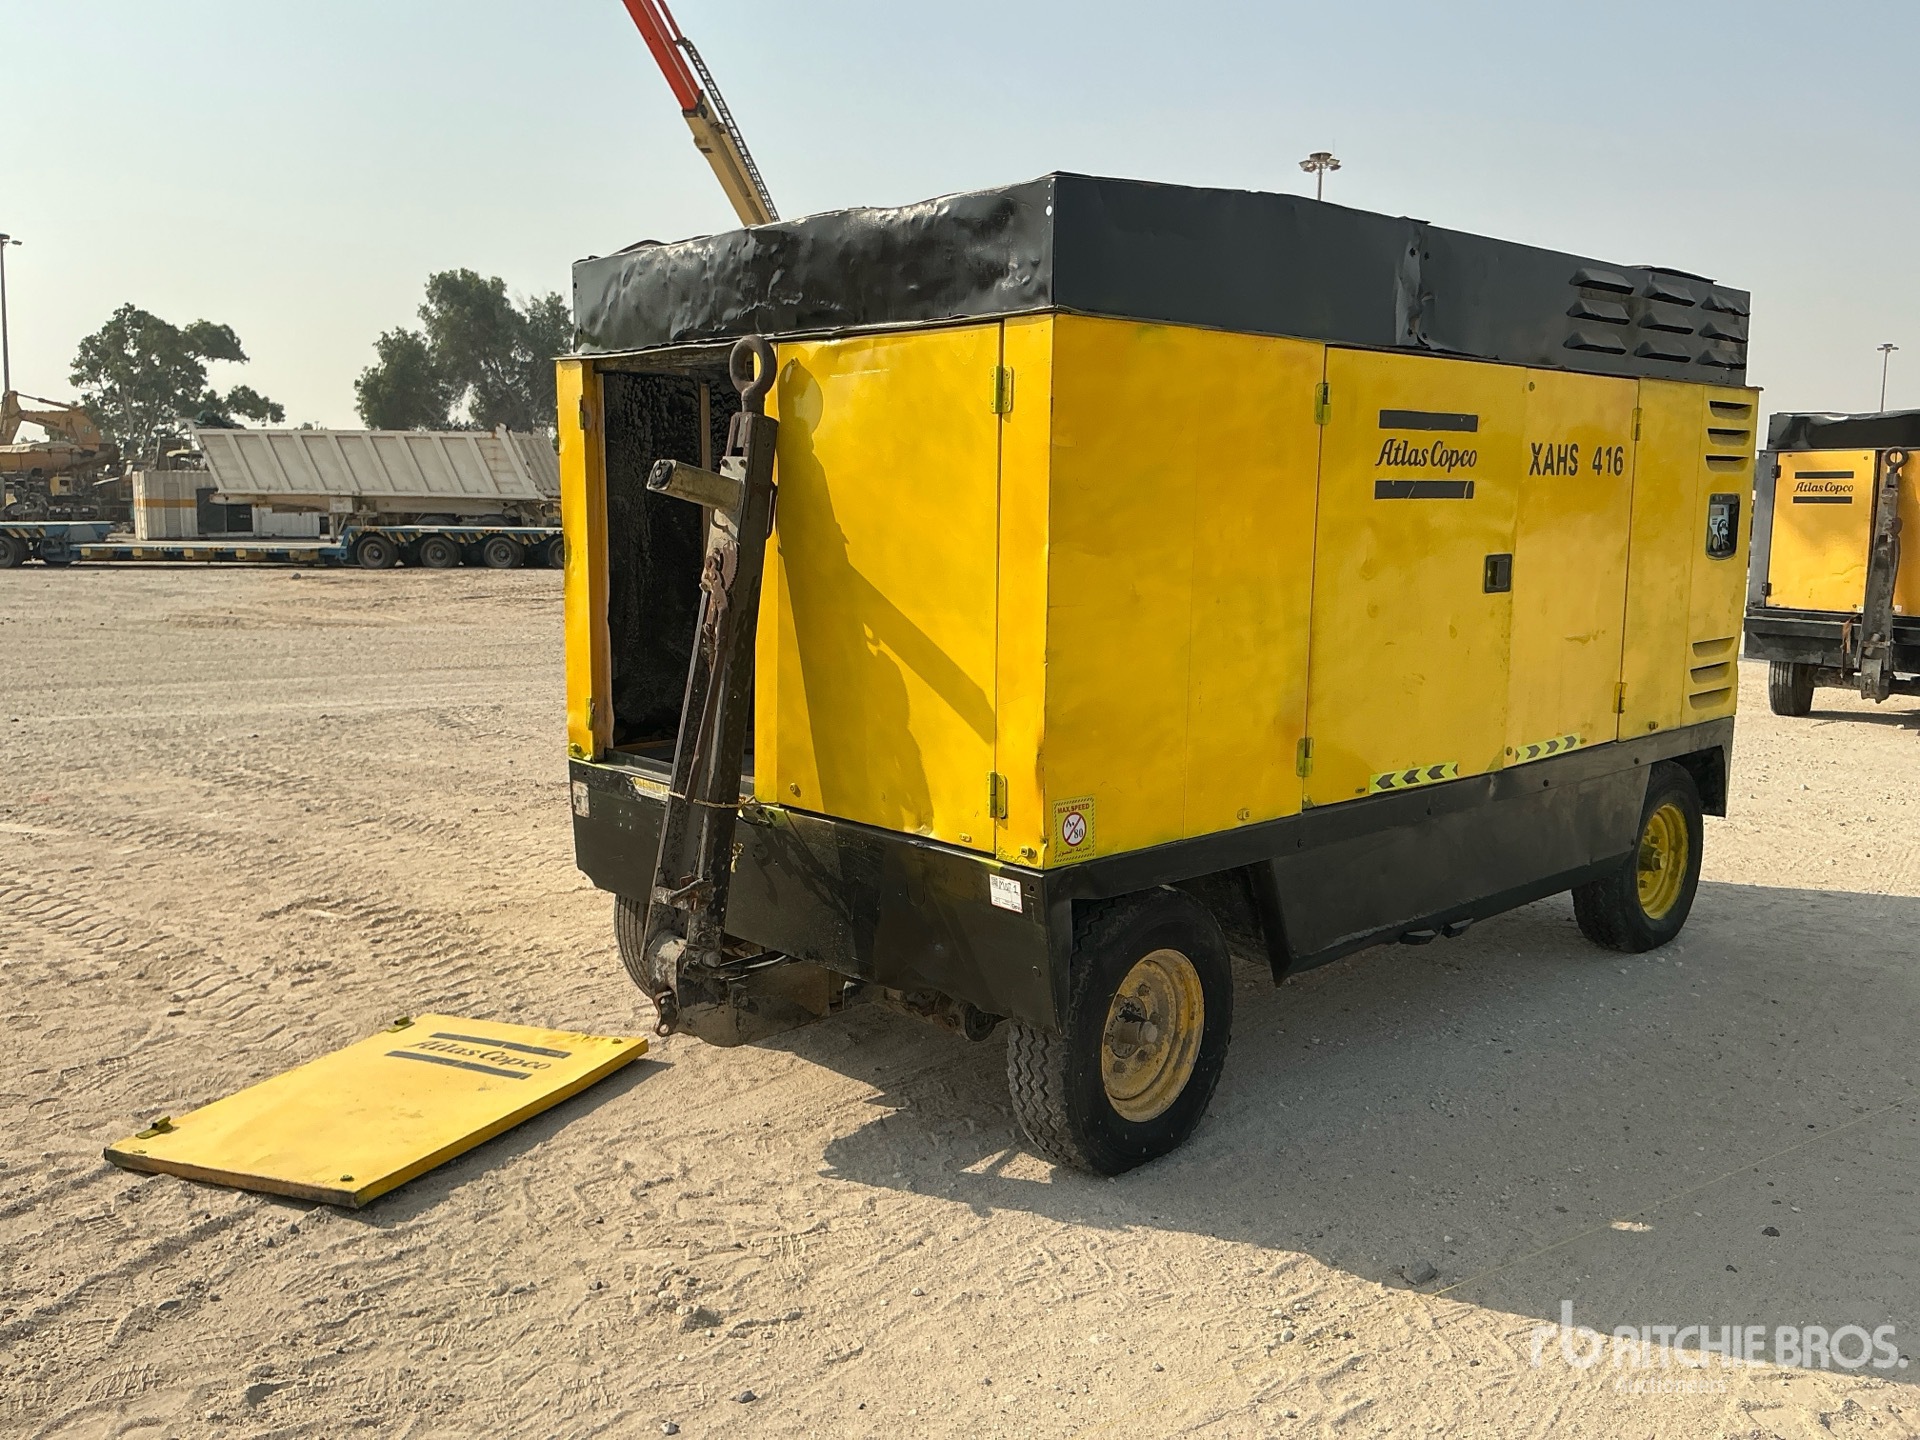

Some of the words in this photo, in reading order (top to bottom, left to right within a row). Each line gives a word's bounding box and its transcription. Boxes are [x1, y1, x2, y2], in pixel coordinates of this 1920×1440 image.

[1375, 438, 1429, 468] Atlas
[1430, 440, 1478, 473] Copco
[1529, 442, 1579, 477] XAHS
[1592, 446, 1624, 476] 416
[1793, 481, 1823, 493] Atlas
[1824, 481, 1854, 494] Copco
[1071, 803, 1090, 812] SPEED
[1073, 827, 1084, 839] 80
[404, 1040, 480, 1057] Atlas
[478, 1050, 552, 1070] Copco
